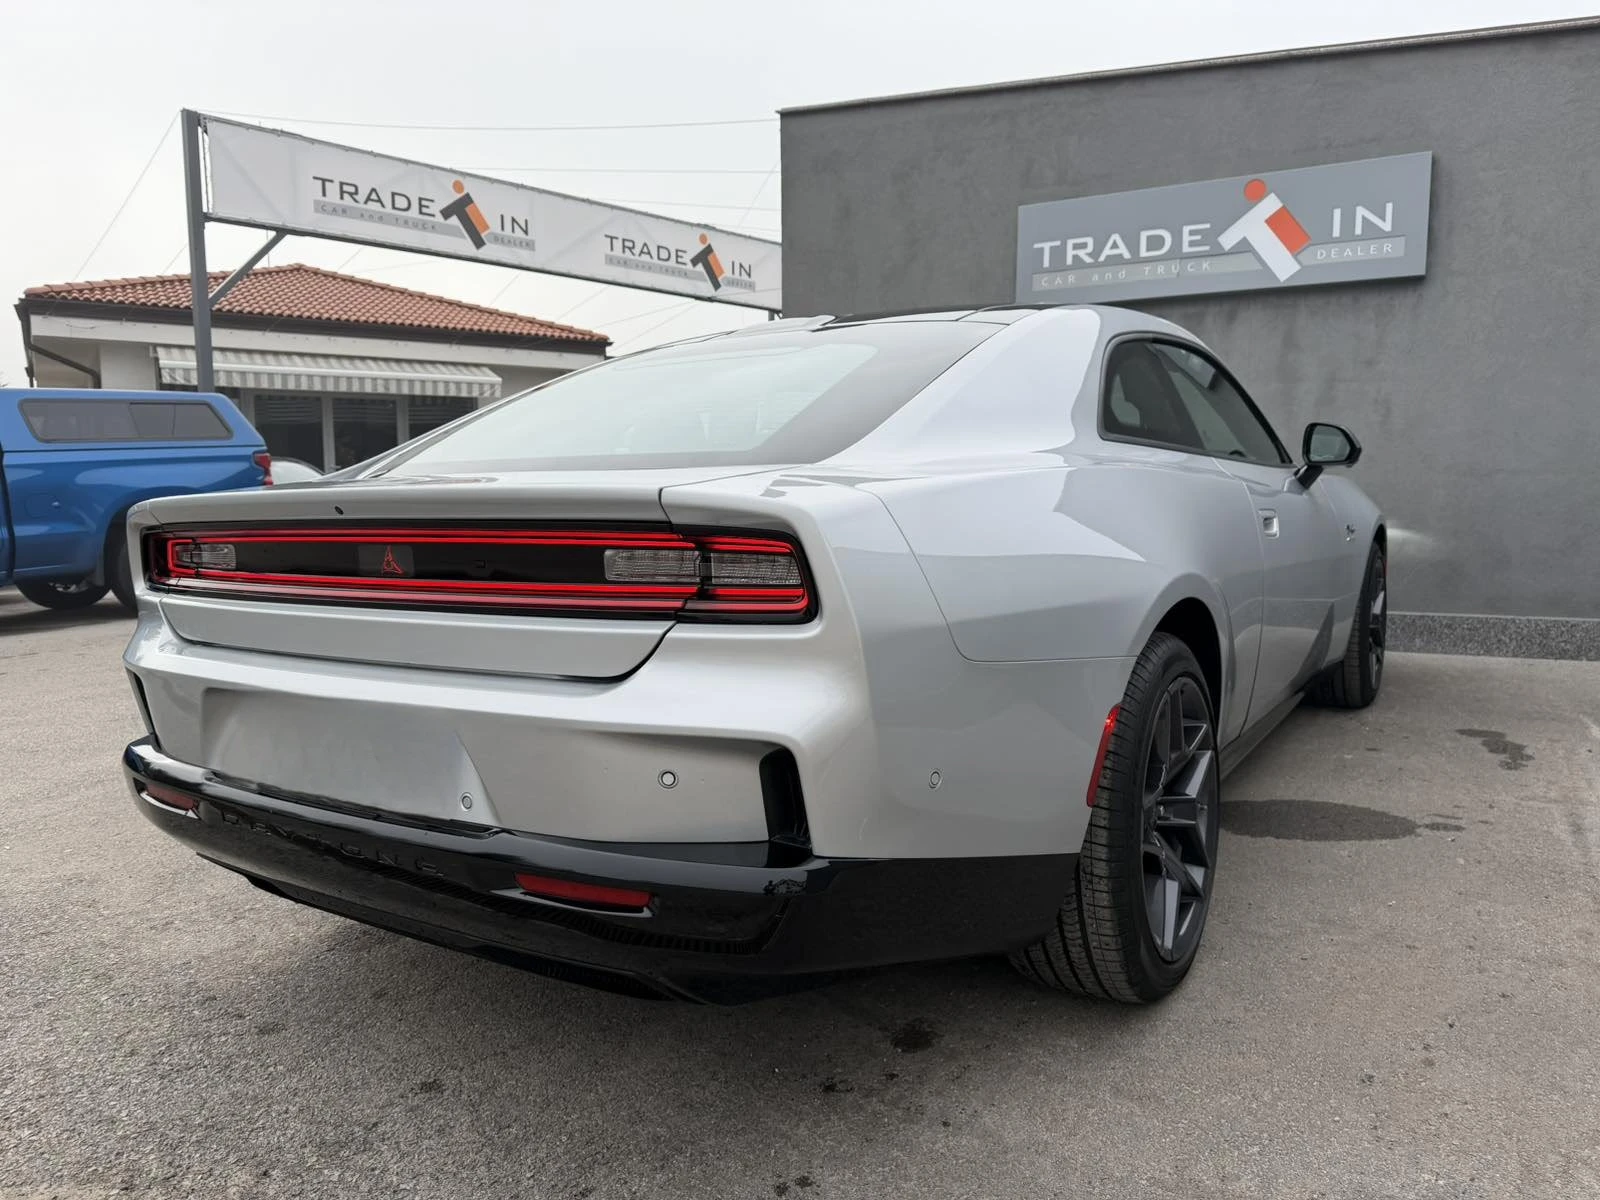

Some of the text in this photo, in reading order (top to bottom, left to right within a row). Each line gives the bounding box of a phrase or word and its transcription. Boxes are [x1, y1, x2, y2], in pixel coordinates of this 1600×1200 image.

[312, 176, 437, 217] TRADE
[500, 214, 530, 236] IN
[604, 234, 688, 266] TRADE
[732, 260, 752, 278] IN
[1033, 223, 1212, 268] TRADE
[1332, 202, 1393, 238] IN
[1316, 242, 1394, 260] DEALER
[1041, 259, 1212, 289] CAR and TRUCK
